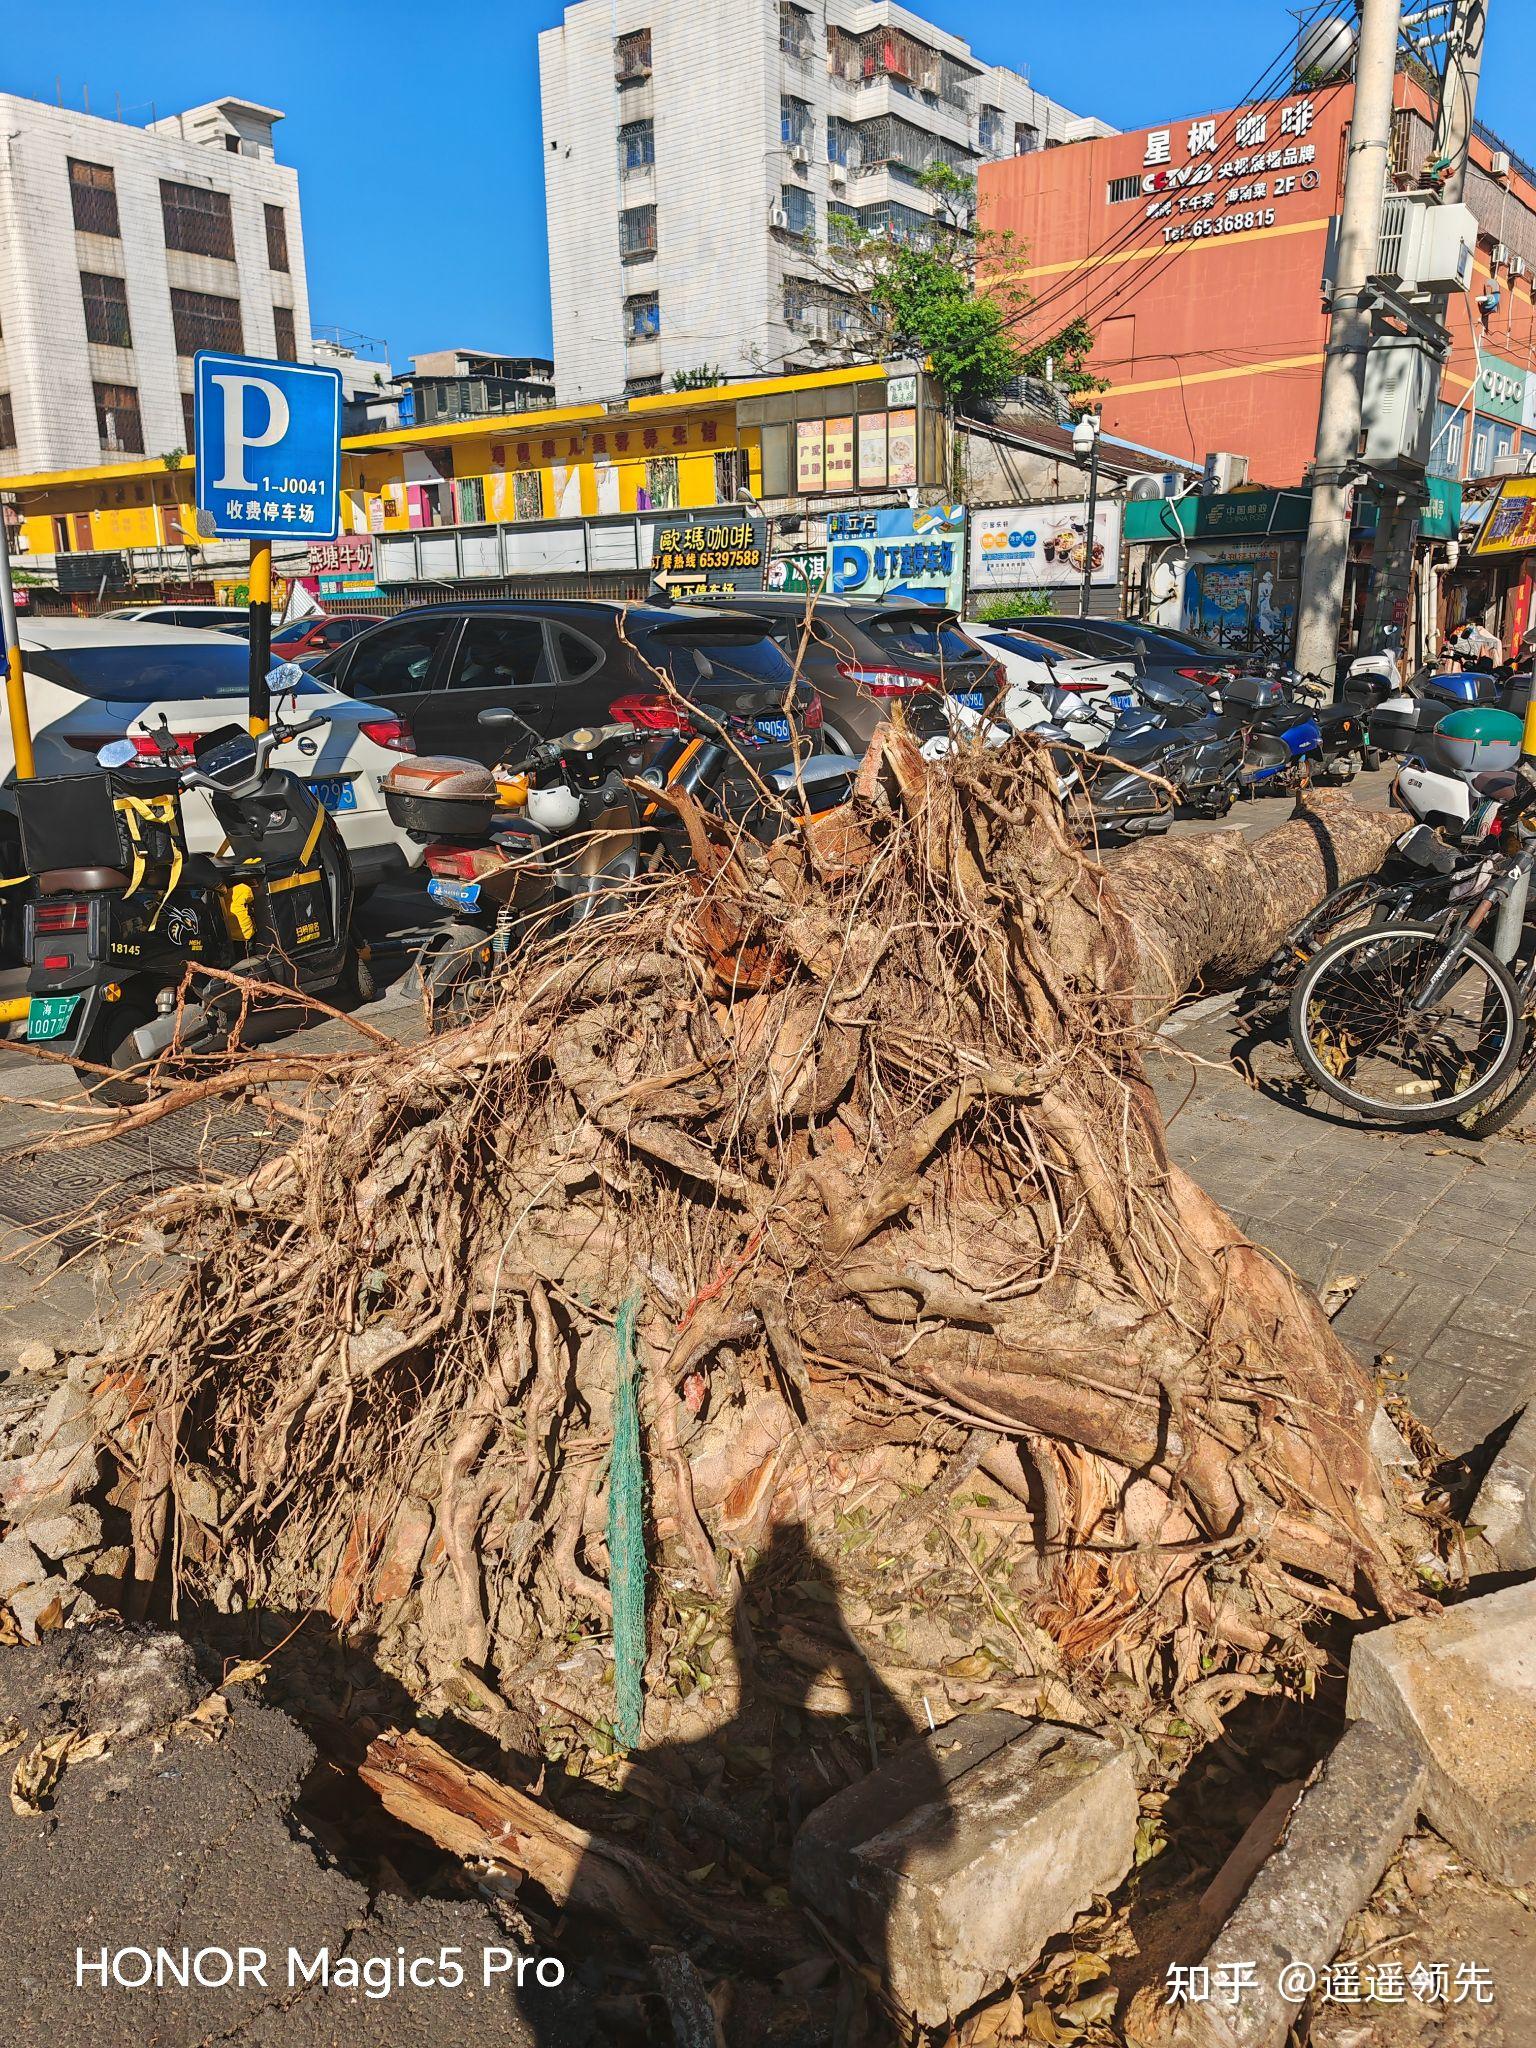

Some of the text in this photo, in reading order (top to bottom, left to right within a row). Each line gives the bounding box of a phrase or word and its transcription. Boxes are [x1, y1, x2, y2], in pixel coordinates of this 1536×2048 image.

[1143, 99, 1314, 168] 星枫咖啡
[1219, 144, 1316, 180] 央视展播品牌
[1178, 192, 1216, 214] 下午茶
[1225, 182, 1267, 204] 海南菜
[1273, 176, 1296, 196] 2F
[211, 374, 290, 491] P
[262, 476, 325, 496] 1-J0041
[226, 500, 315, 523] 收费停车场
[1226, 503, 1268, 517] 中国邮政
[660, 522, 753, 552] 歐瑪咖啡
[307, 544, 374, 572] 燕塘牛奶
[651, 551, 760, 570] 订餐热线 65397588
[873, 540, 954, 580] 地下室停车场
[110, 942, 141, 956] 18145
